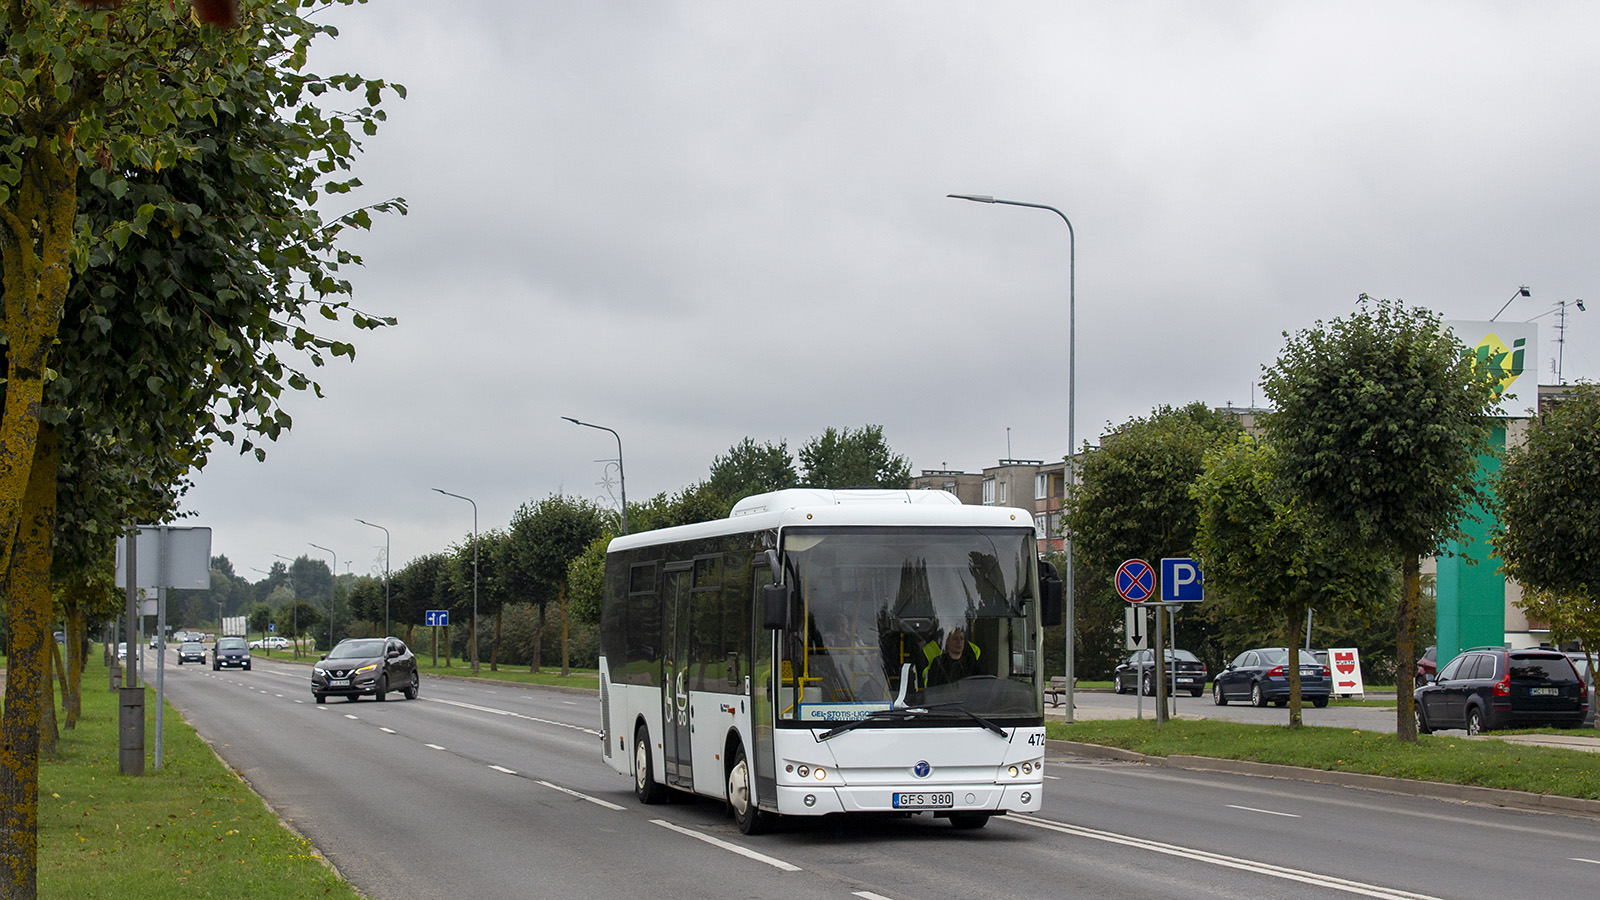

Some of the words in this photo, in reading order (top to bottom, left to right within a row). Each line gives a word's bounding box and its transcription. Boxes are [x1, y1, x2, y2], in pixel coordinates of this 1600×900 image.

[1174, 563, 1196, 597] P
[1028, 734, 1045, 746] 472
[900, 794, 924, 805] GFS
[931, 794, 951, 805] 980
